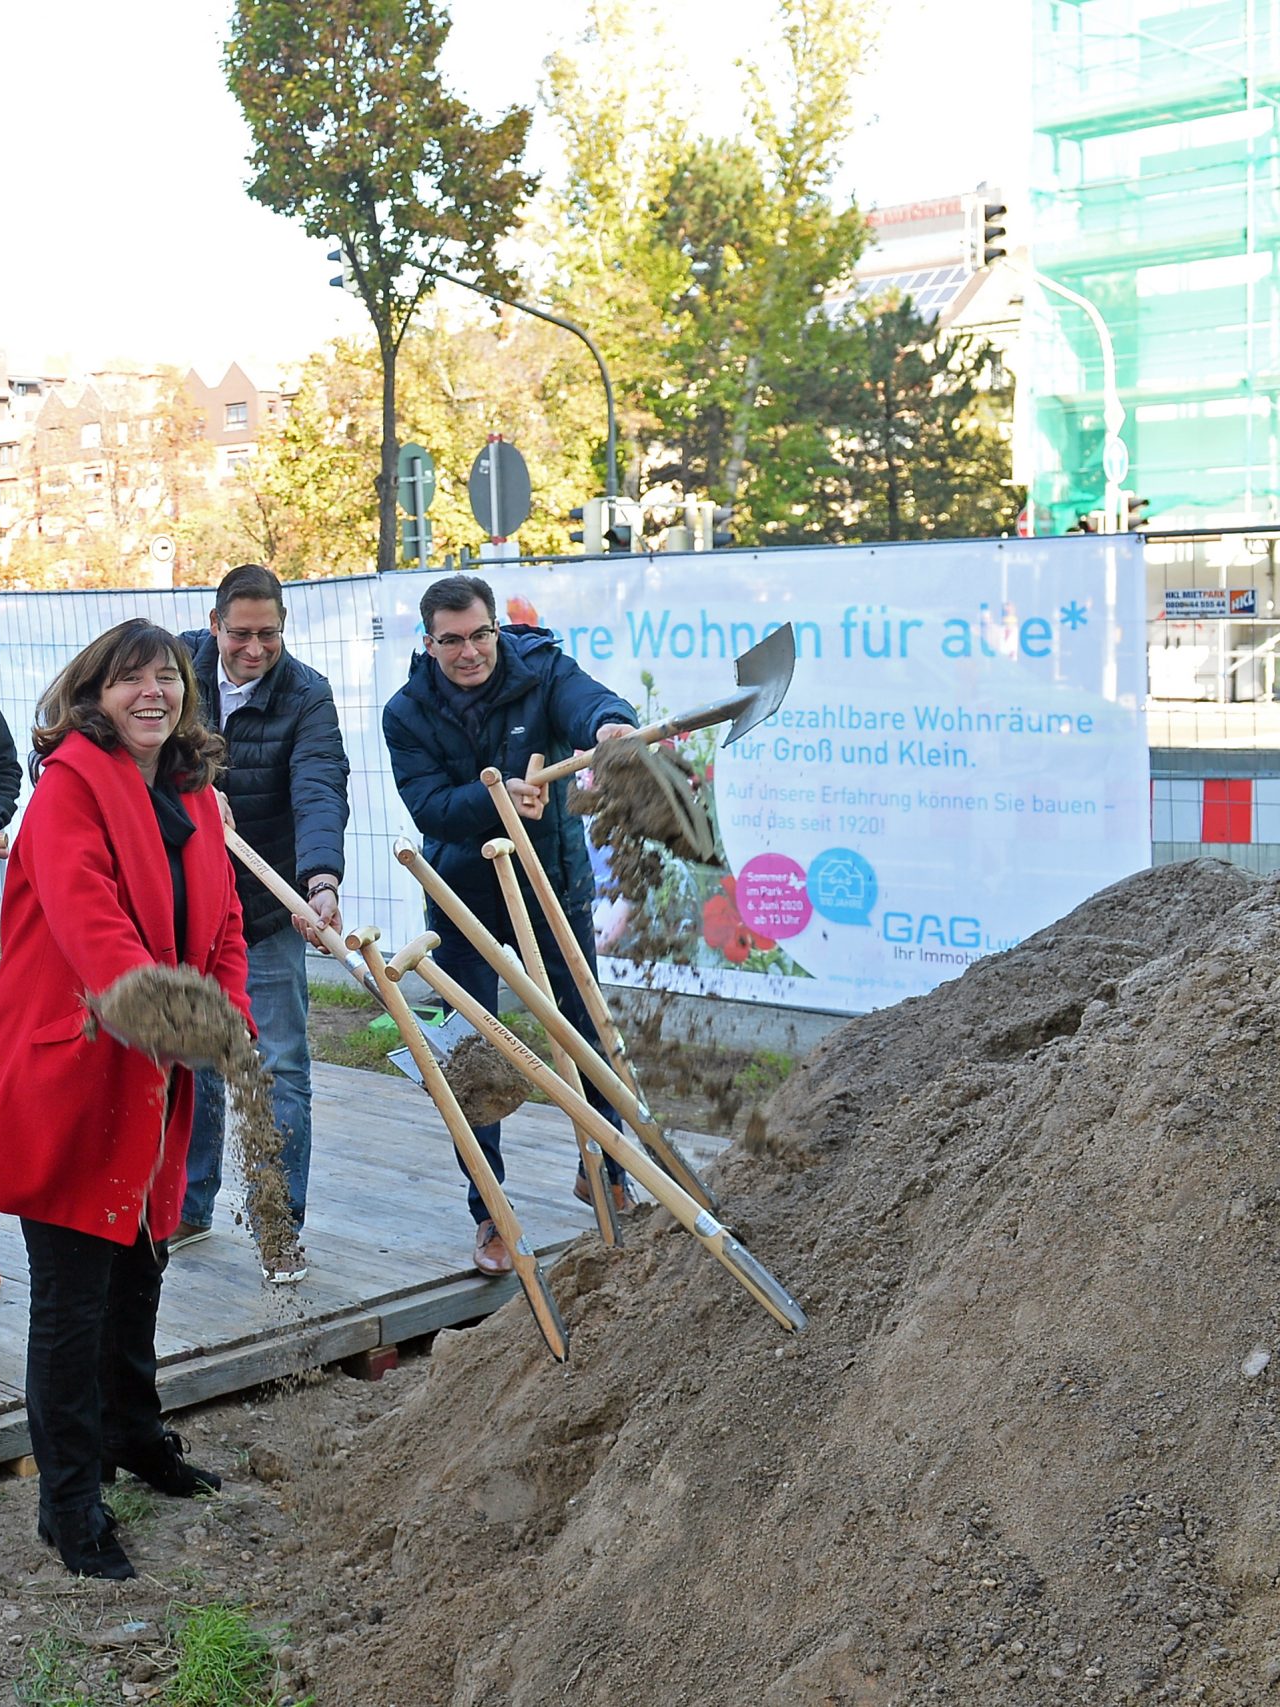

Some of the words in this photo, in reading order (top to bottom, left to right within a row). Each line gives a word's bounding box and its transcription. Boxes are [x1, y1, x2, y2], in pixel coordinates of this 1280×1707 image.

[1231, 591, 1255, 610] HKL
[839, 605, 924, 659] für
[914, 706, 1093, 734] Wohnräume
[731, 736, 765, 761] für
[773, 736, 833, 763] Groß
[840, 740, 889, 766] und
[898, 740, 977, 768] Klein.
[727, 783, 754, 801] Auf
[759, 785, 816, 803] unsere
[821, 785, 911, 812] Erfahrung
[918, 791, 988, 811] können
[994, 792, 1025, 812] Sie
[1032, 794, 1096, 815] bauen
[731, 809, 762, 828] und
[767, 811, 796, 830] das
[800, 814, 832, 833] seit
[838, 815, 887, 835] 1920!
[746, 871, 788, 883] Sommer
[757, 899, 780, 911] Juni
[883, 911, 982, 949] GAG
[893, 945, 915, 961] Ihr
